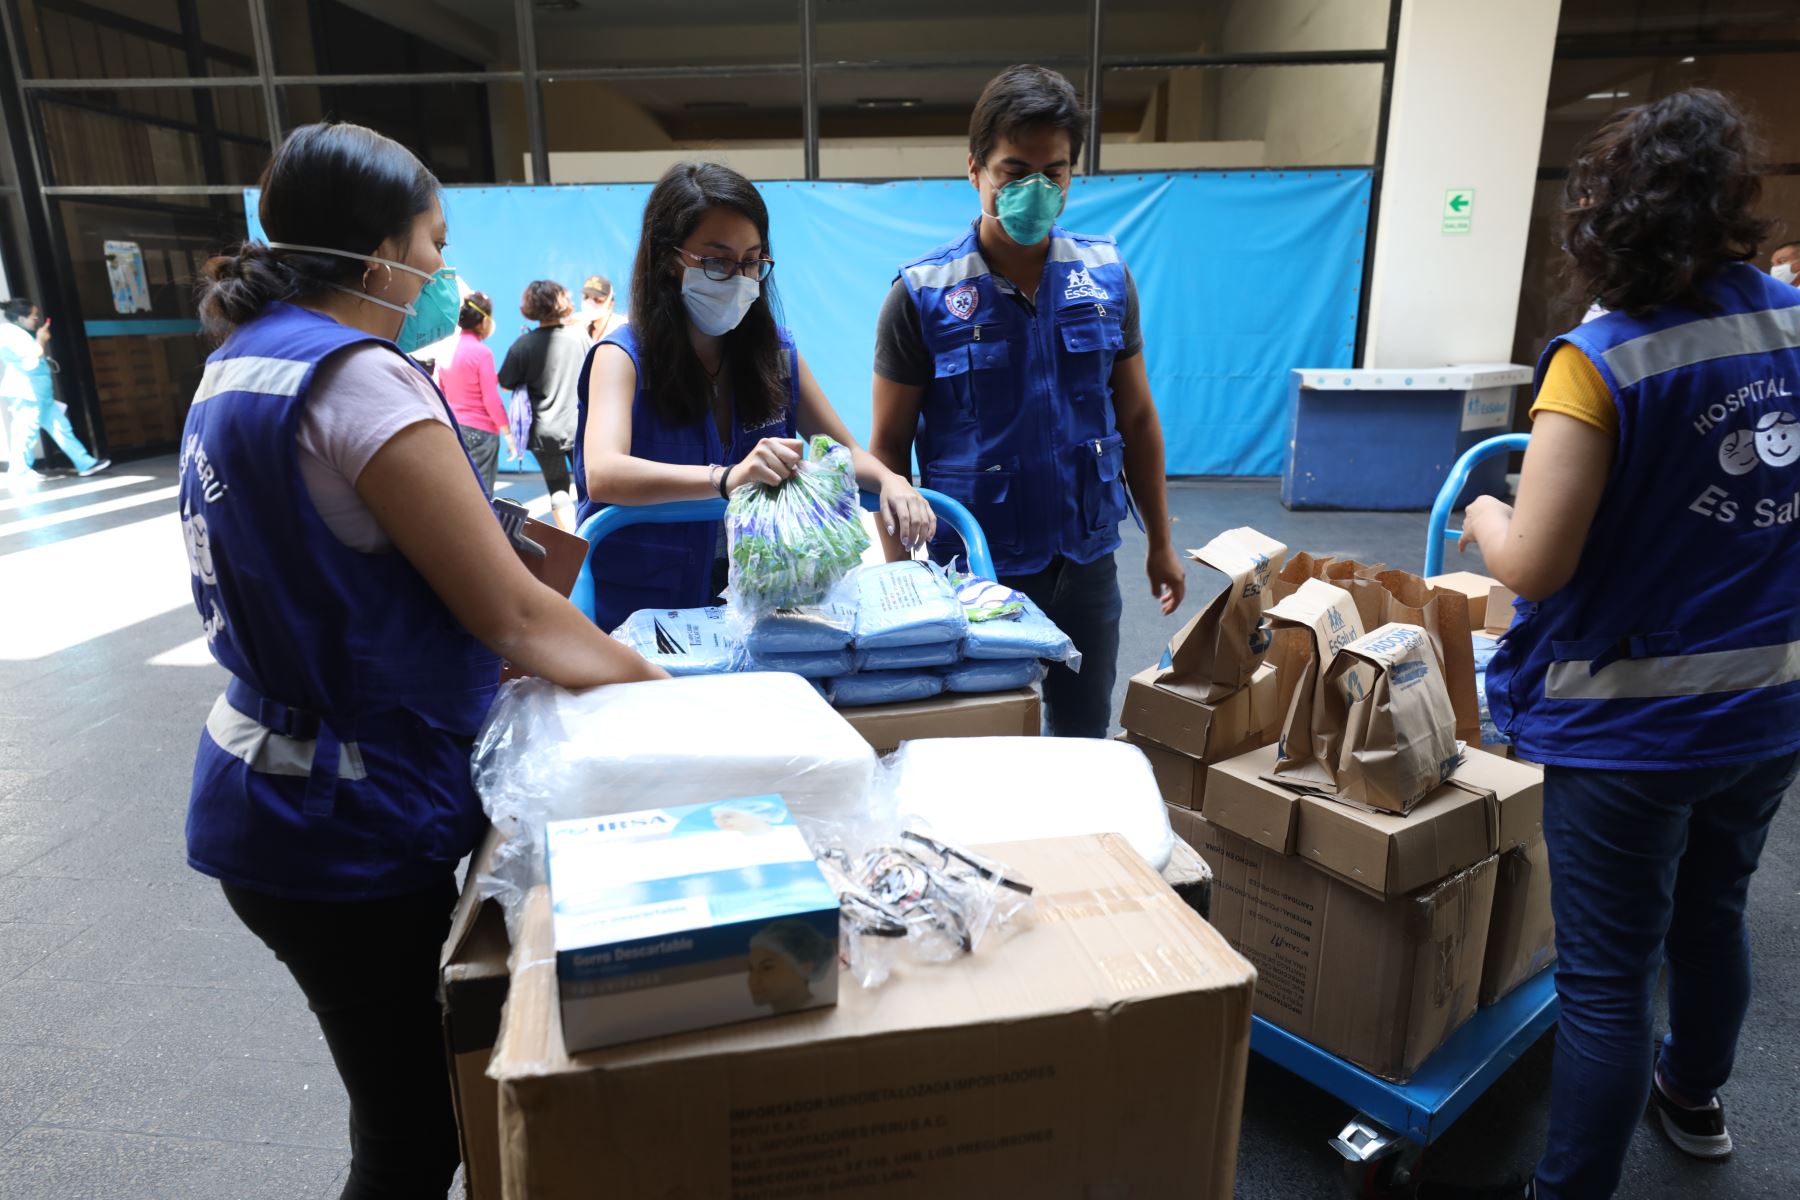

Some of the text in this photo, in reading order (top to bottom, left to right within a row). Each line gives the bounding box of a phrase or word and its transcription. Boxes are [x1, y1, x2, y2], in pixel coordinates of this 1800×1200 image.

[1064, 286, 1109, 300] EsSalud
[1693, 377, 1793, 435] HOSPITAL
[1688, 484, 1740, 523] Es
[1365, 628, 1419, 654] PADOMI
[614, 936, 695, 962] Descartable
[953, 1064, 1056, 1091] IMPORTADORES
